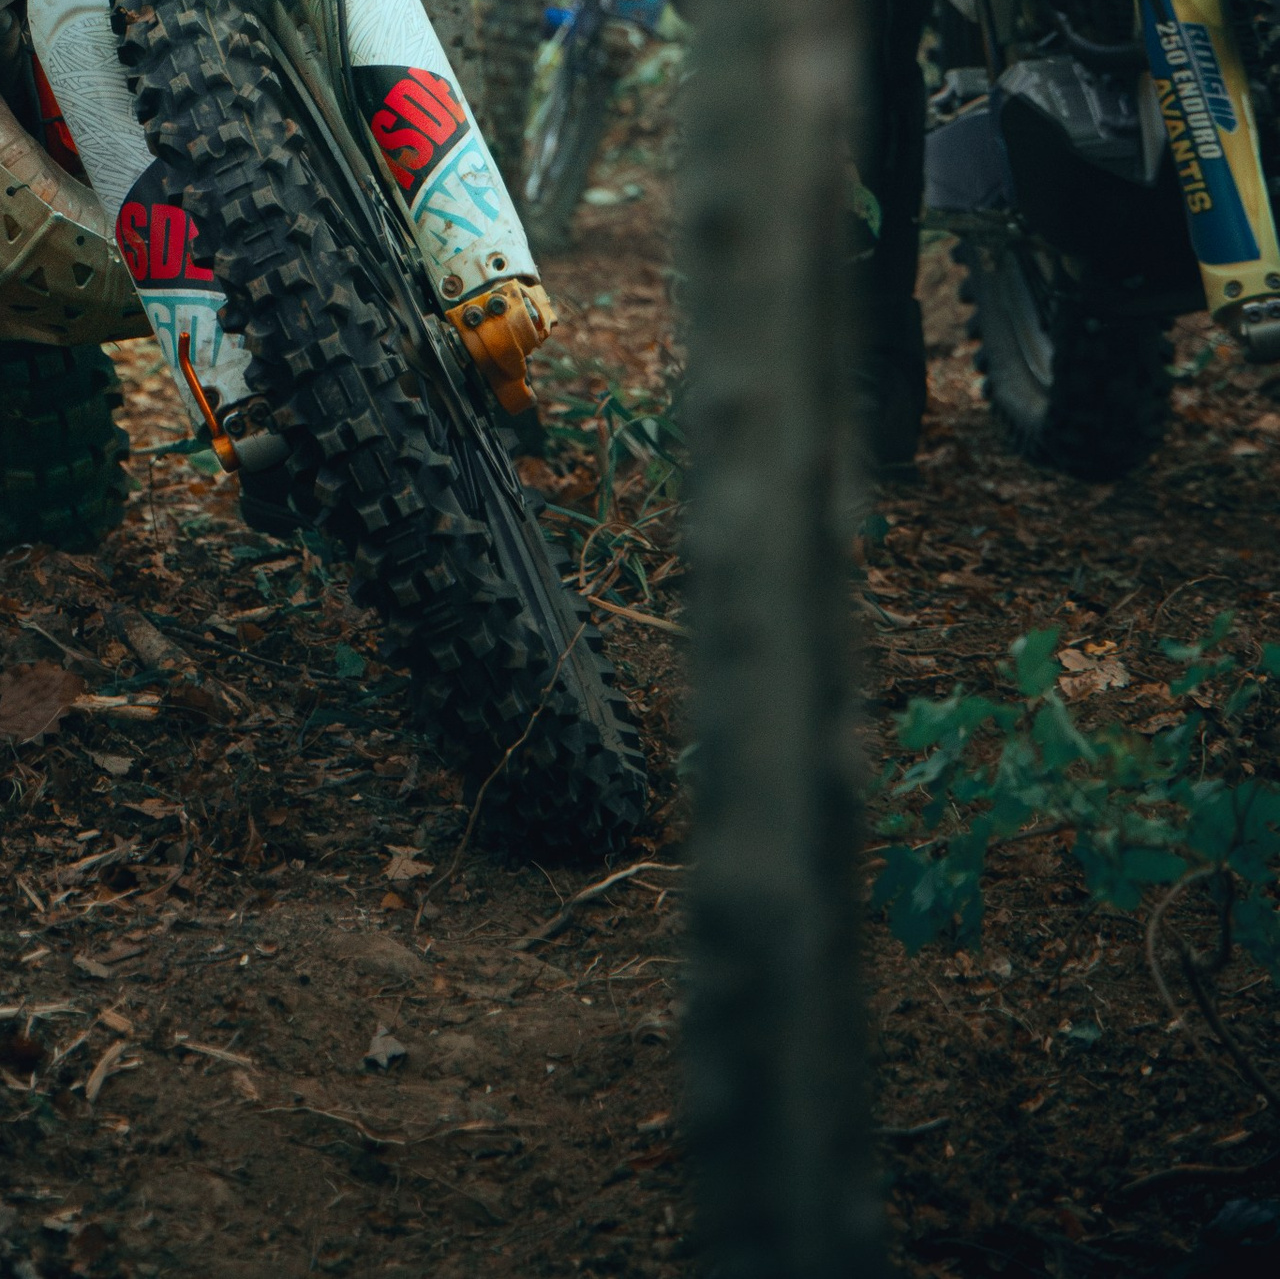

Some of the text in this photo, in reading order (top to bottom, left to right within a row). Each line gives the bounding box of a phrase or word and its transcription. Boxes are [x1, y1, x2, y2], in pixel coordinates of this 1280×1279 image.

[1154, 78, 1213, 215] AVANTIS
[1155, 21, 1189, 66] 250
[1172, 68, 1223, 160] ENDURO
